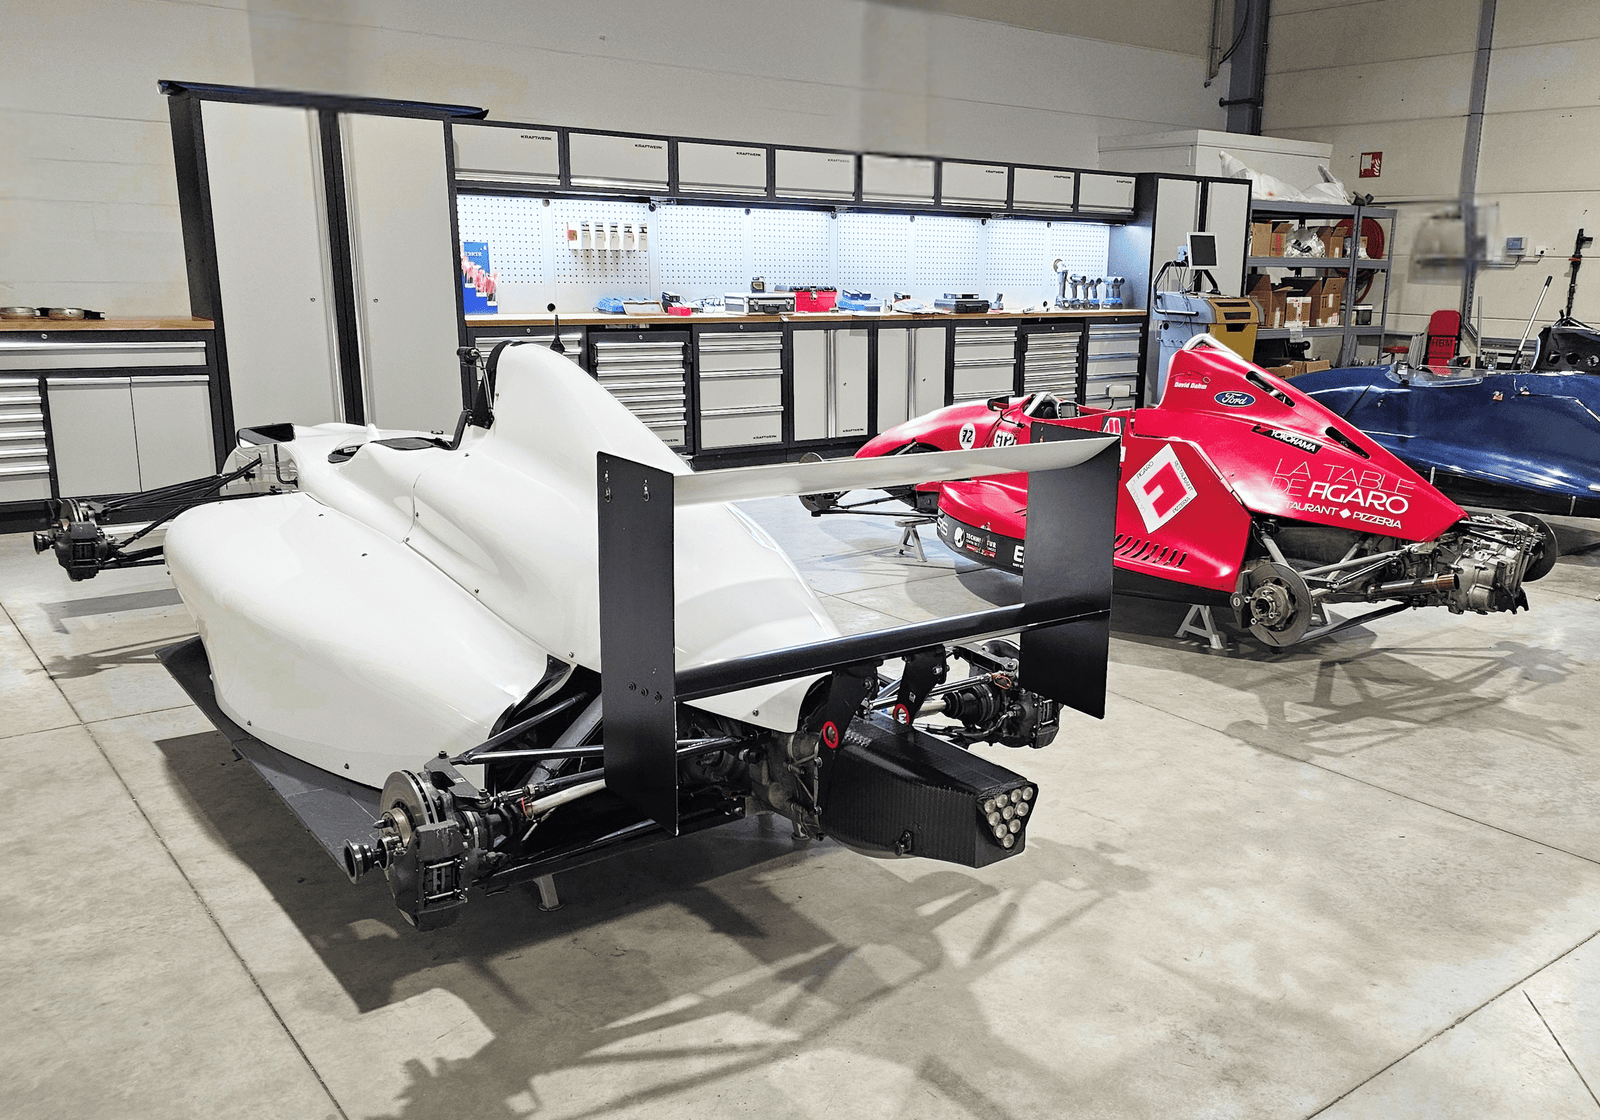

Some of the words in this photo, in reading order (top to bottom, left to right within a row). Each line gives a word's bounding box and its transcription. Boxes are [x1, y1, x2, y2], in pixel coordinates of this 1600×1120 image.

[1432, 338, 1454, 347] HBM
[1174, 381, 1190, 389] David
[1221, 392, 1248, 405] Ford
[962, 429, 974, 443] 72
[1270, 430, 1316, 452] YOKOHAMA
[1274, 458, 1311, 479] LA
[1323, 463, 1417, 498] TABLE
[1269, 476, 1307, 497] DE
[1308, 481, 1409, 515] FIGARO
[1352, 511, 1402, 530] PIZZERIA
